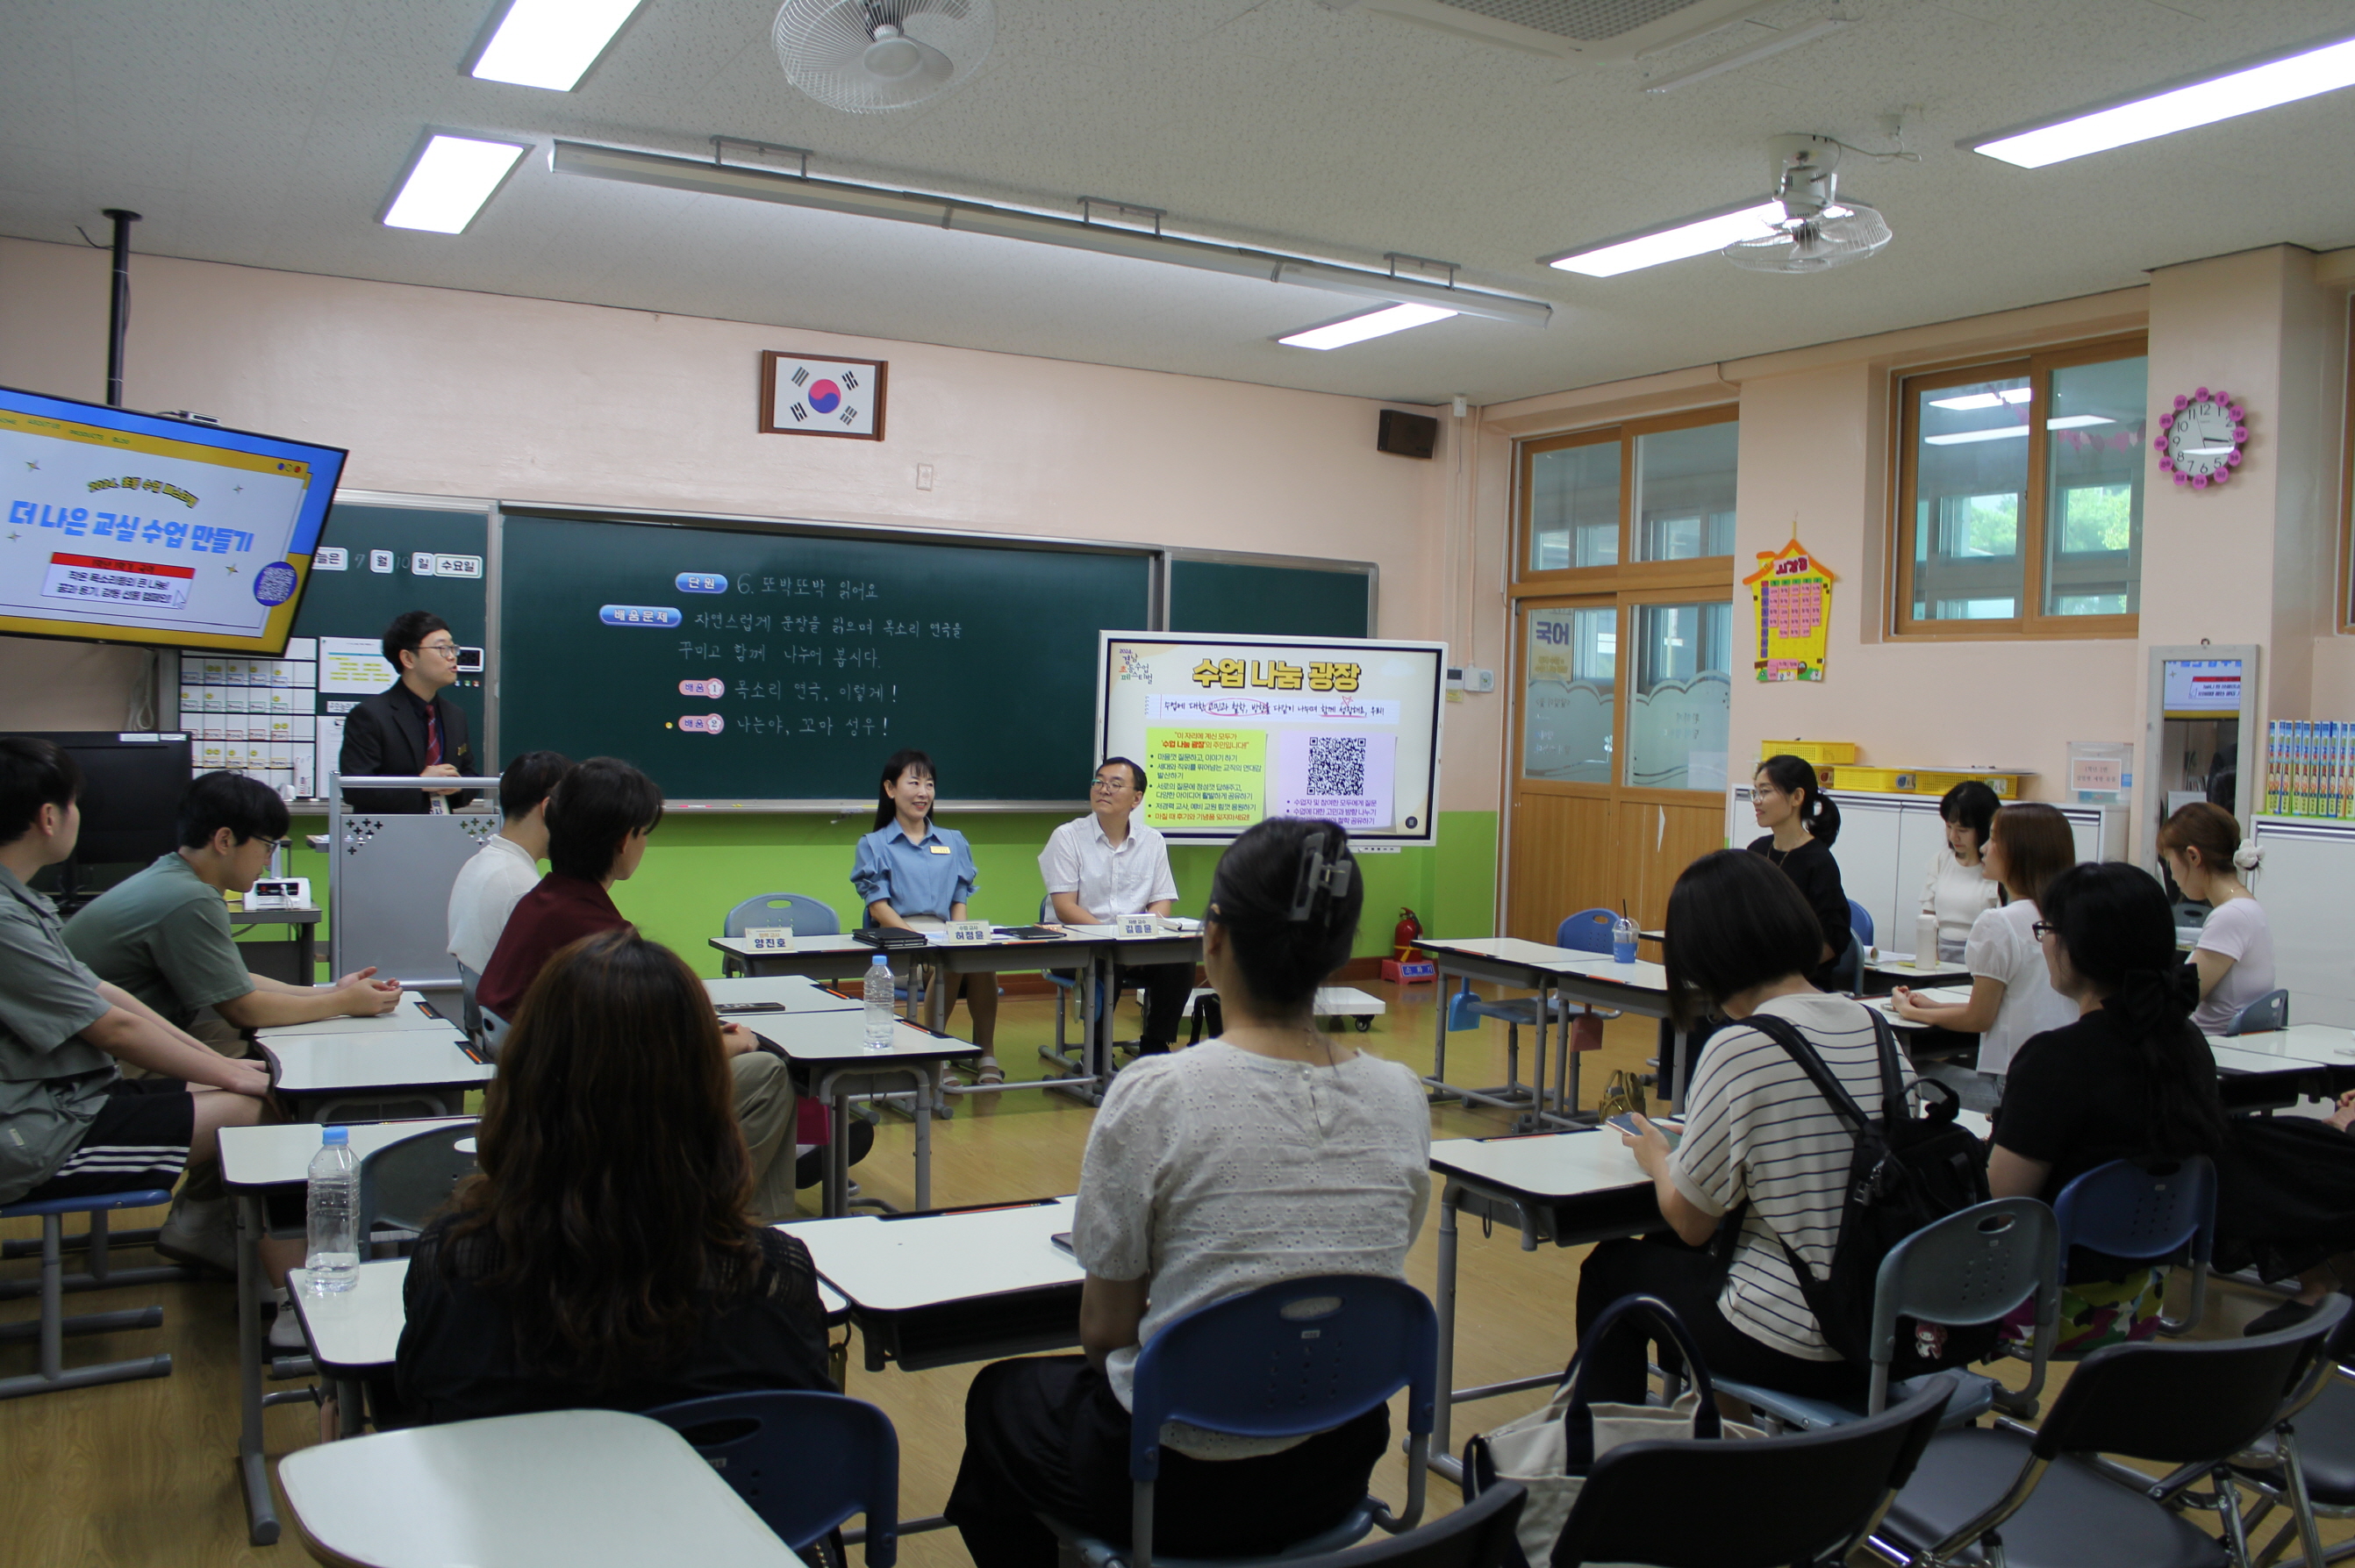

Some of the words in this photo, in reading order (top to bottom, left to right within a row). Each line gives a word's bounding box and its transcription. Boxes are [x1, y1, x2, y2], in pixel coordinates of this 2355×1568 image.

[2188, 409, 2195, 420] 11
[2200, 404, 2211, 416] 12
[2177, 421, 2188, 433] 10
[2172, 436, 2180, 447] 9
[2176, 451, 2185, 462] 8
[2187, 461, 2194, 472] 7
[2200, 462, 2208, 474] 6
[2214, 457, 2222, 469] 5
[9, 499, 38, 526] 더
[40, 504, 89, 537] 나은
[92, 511, 140, 543] 교실
[141, 520, 190, 550] 수업
[190, 524, 255, 555] 만들기
[314, 552, 340, 565] 늘은
[354, 554, 365, 569] 7
[418, 558, 429, 569] 일
[441, 560, 475, 573] 수요일
[688, 576, 715, 590] 단원
[737, 573, 754, 594] 6.
[761, 576, 826, 598] 또박또박
[840, 580, 878, 600] 읽어요
[614, 609, 669, 623] 배움문제
[695, 612, 770, 632] 자연스럽게
[781, 615, 821, 634] 문장을
[833, 616, 872, 635] 읽으며
[883, 619, 920, 638] 목소리
[930, 622, 963, 639] 연극을
[1535, 621, 1570, 645] 국어
[678, 641, 721, 660] 꾸미고
[734, 643, 766, 662] 함께
[784, 644, 821, 666] 나누어
[1192, 657, 1246, 689] 수업
[1250, 659, 1304, 691] 나눔
[1307, 661, 1362, 692] 광장
[684, 683, 704, 693] 배움
[734, 679, 781, 699] 목소리
[1164, 700, 1185, 712] 수업에
[1321, 704, 1336, 715] 함께
[684, 719, 704, 728] 배움
[737, 714, 790, 736] 나는야,
[798, 716, 834, 736] 꼬마
[1157, 753, 1177, 762] 마음껏
[956, 930, 984, 941] 허정윤
[755, 938, 786, 949] 양진호
